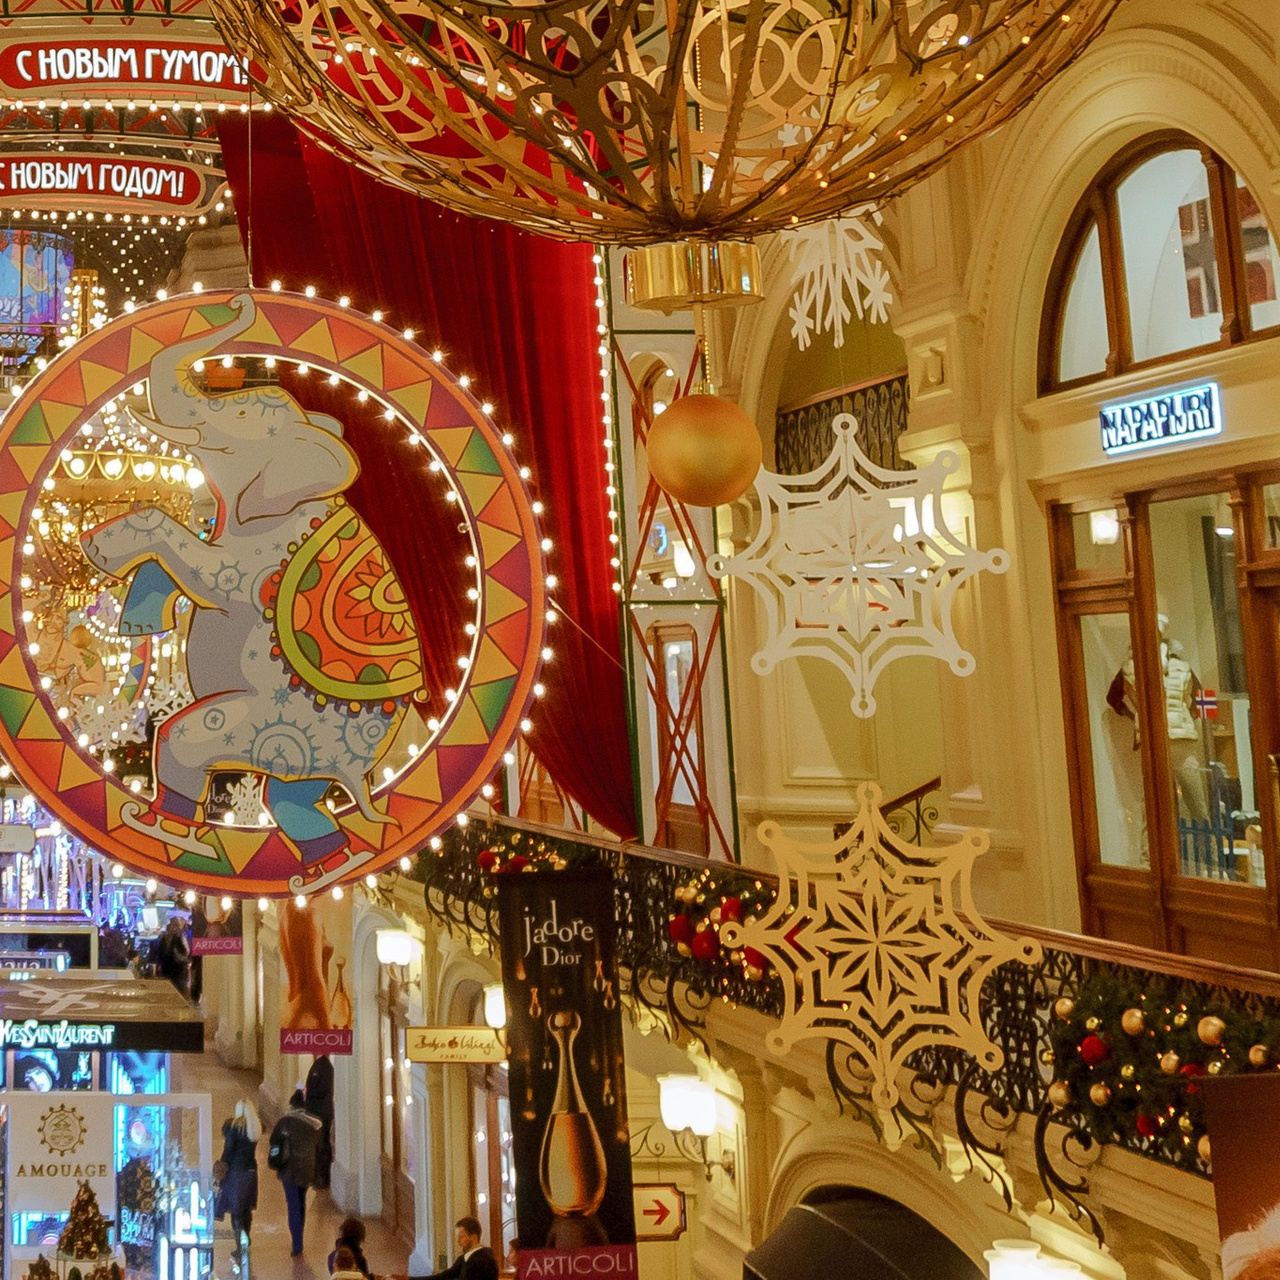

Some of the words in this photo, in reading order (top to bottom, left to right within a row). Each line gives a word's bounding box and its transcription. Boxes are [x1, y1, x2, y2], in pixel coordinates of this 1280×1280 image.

[16, 50, 33, 81] С
[37, 47, 139, 80] НОВЫМ
[144, 48, 249, 86] ГУМОМ!
[10, 161, 94, 190] НОВЫМ
[98, 163, 185, 198] ГОДОМ!
[1101, 388, 1214, 449] NAPAPIJRI
[523, 899, 595, 958] j'adore
[194, 940, 242, 950] ARTICOLI
[541, 946, 582, 966] Dior
[283, 1032, 351, 1046] ARTICOLI
[16, 1163, 108, 1178] AMOUAGE
[525, 1252, 634, 1277] ARTICOLI
